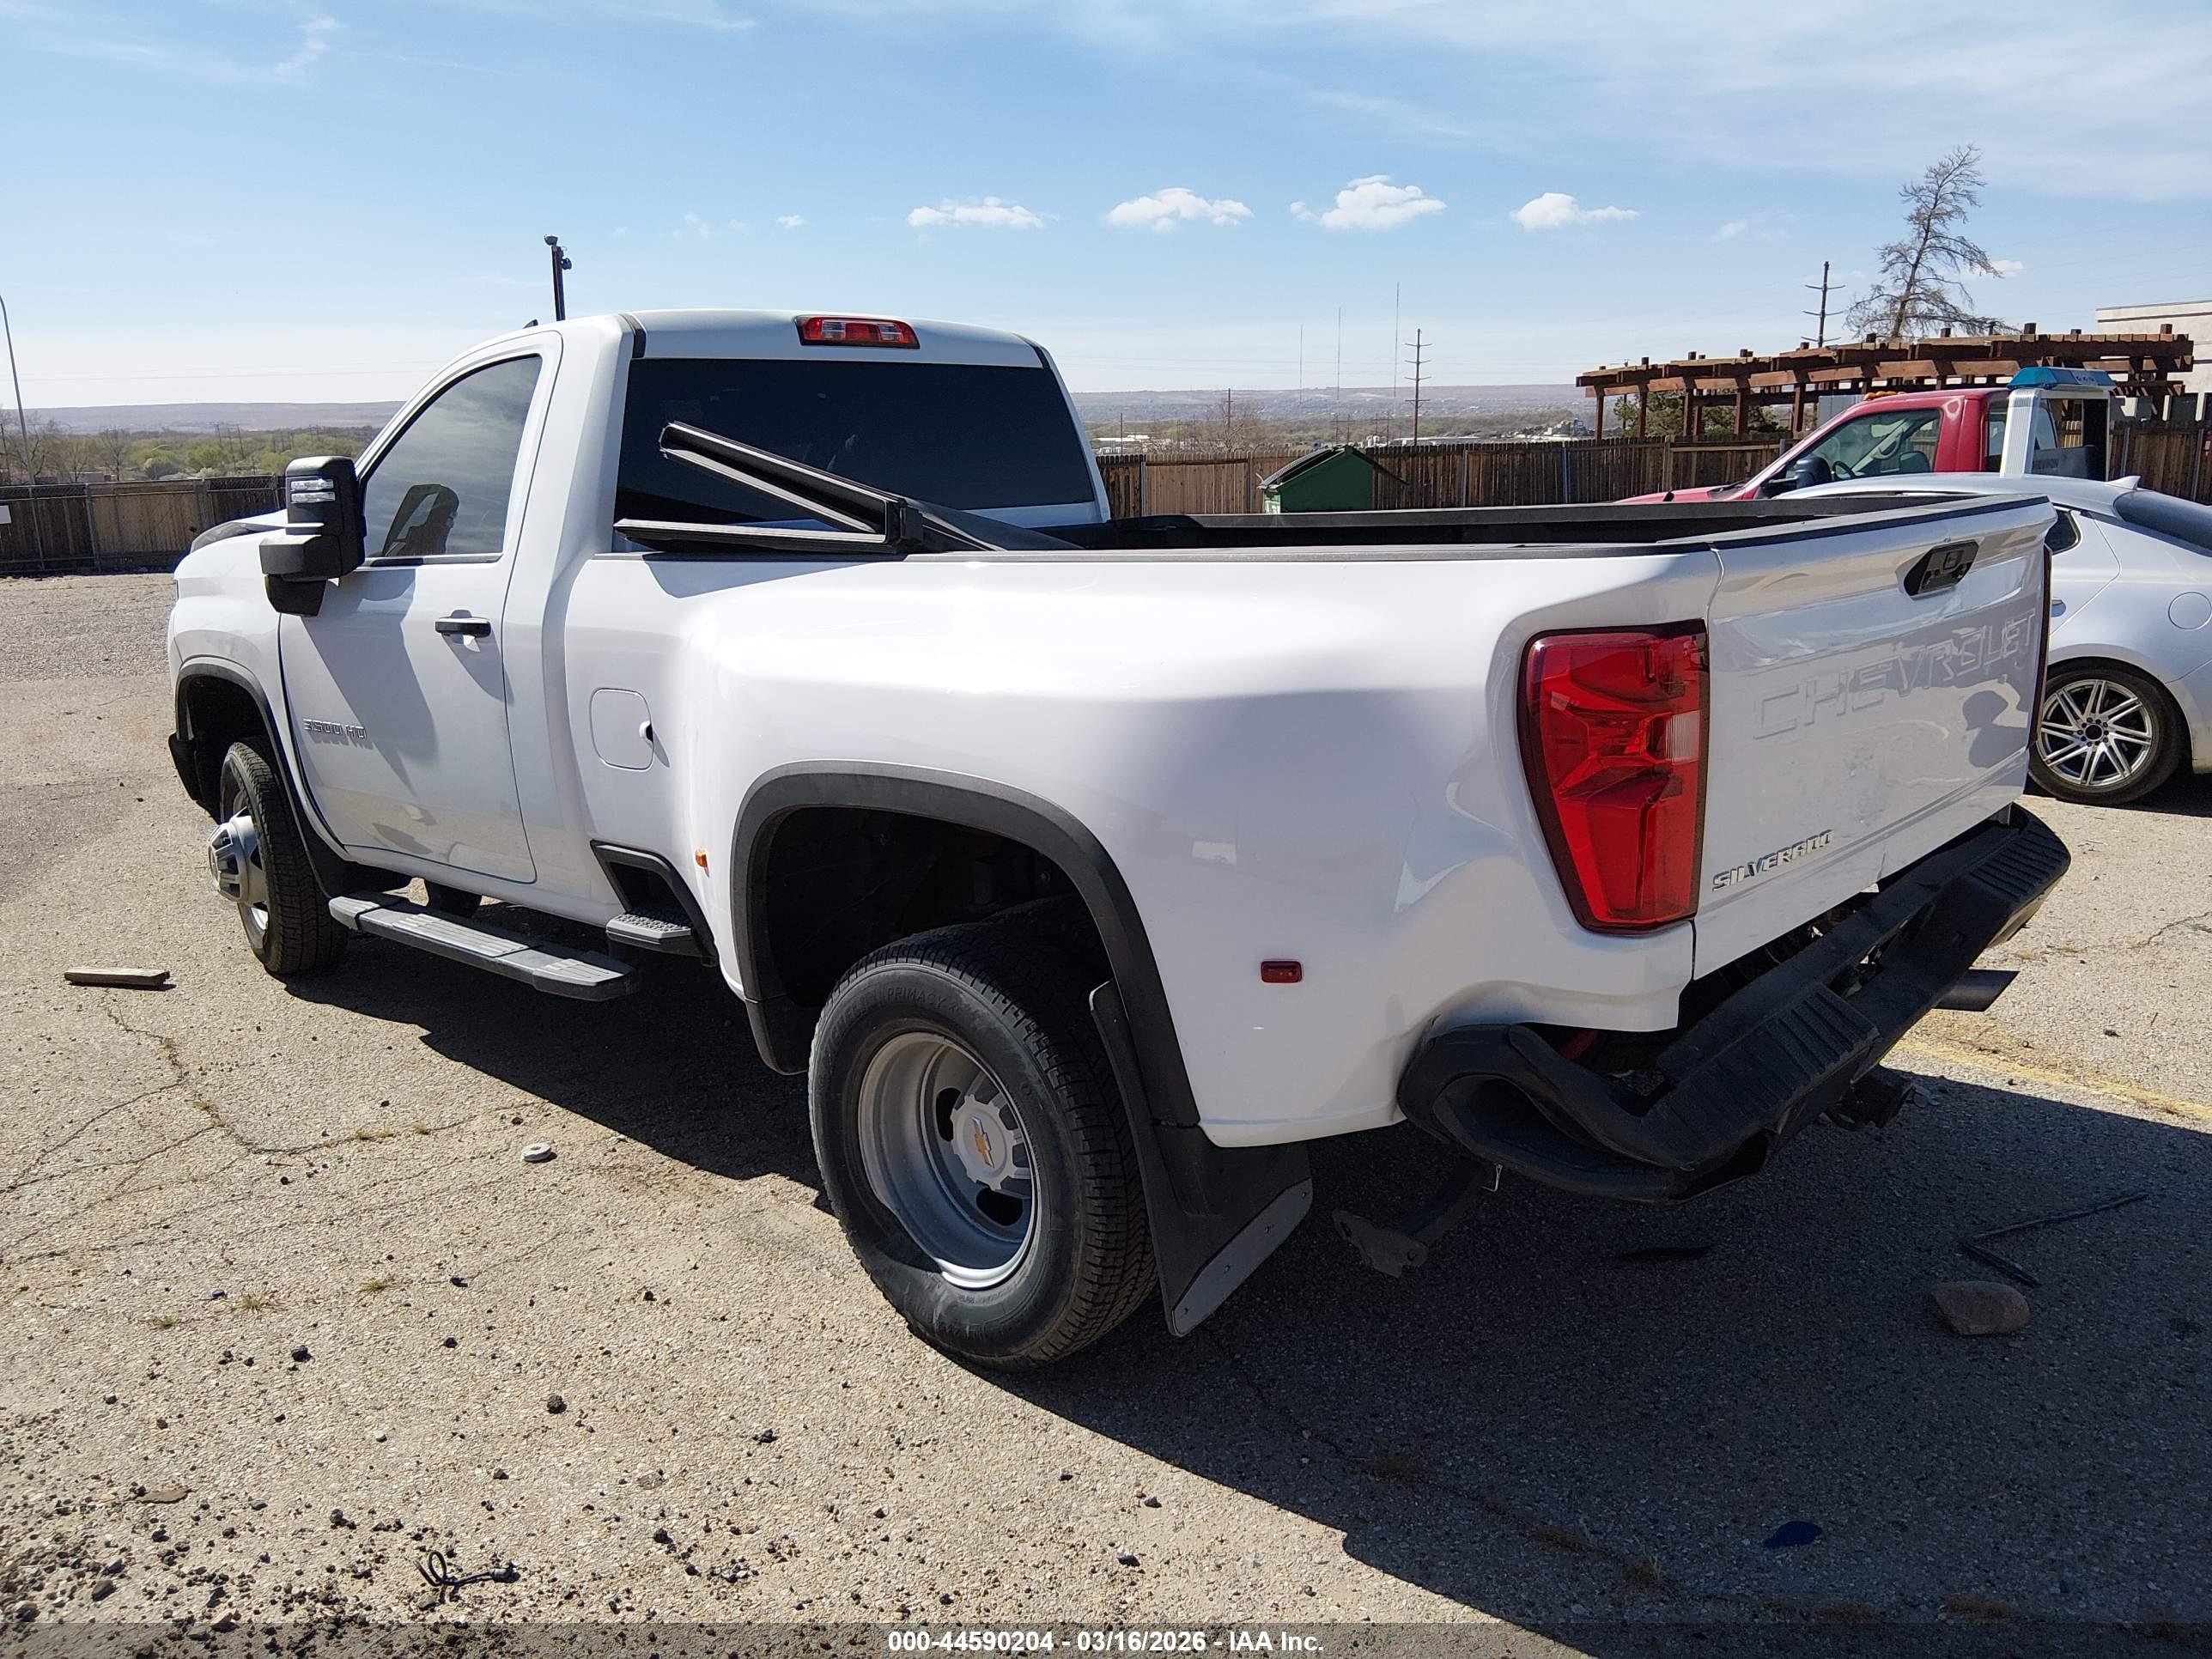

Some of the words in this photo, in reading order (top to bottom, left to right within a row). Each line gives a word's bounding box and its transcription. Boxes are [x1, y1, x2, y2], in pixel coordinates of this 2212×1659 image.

[1753, 608, 2037, 740] CHEVROLET
[302, 719, 344, 736] 3500
[345, 725, 367, 739] HD
[1711, 830, 1834, 891] SILVERADO
